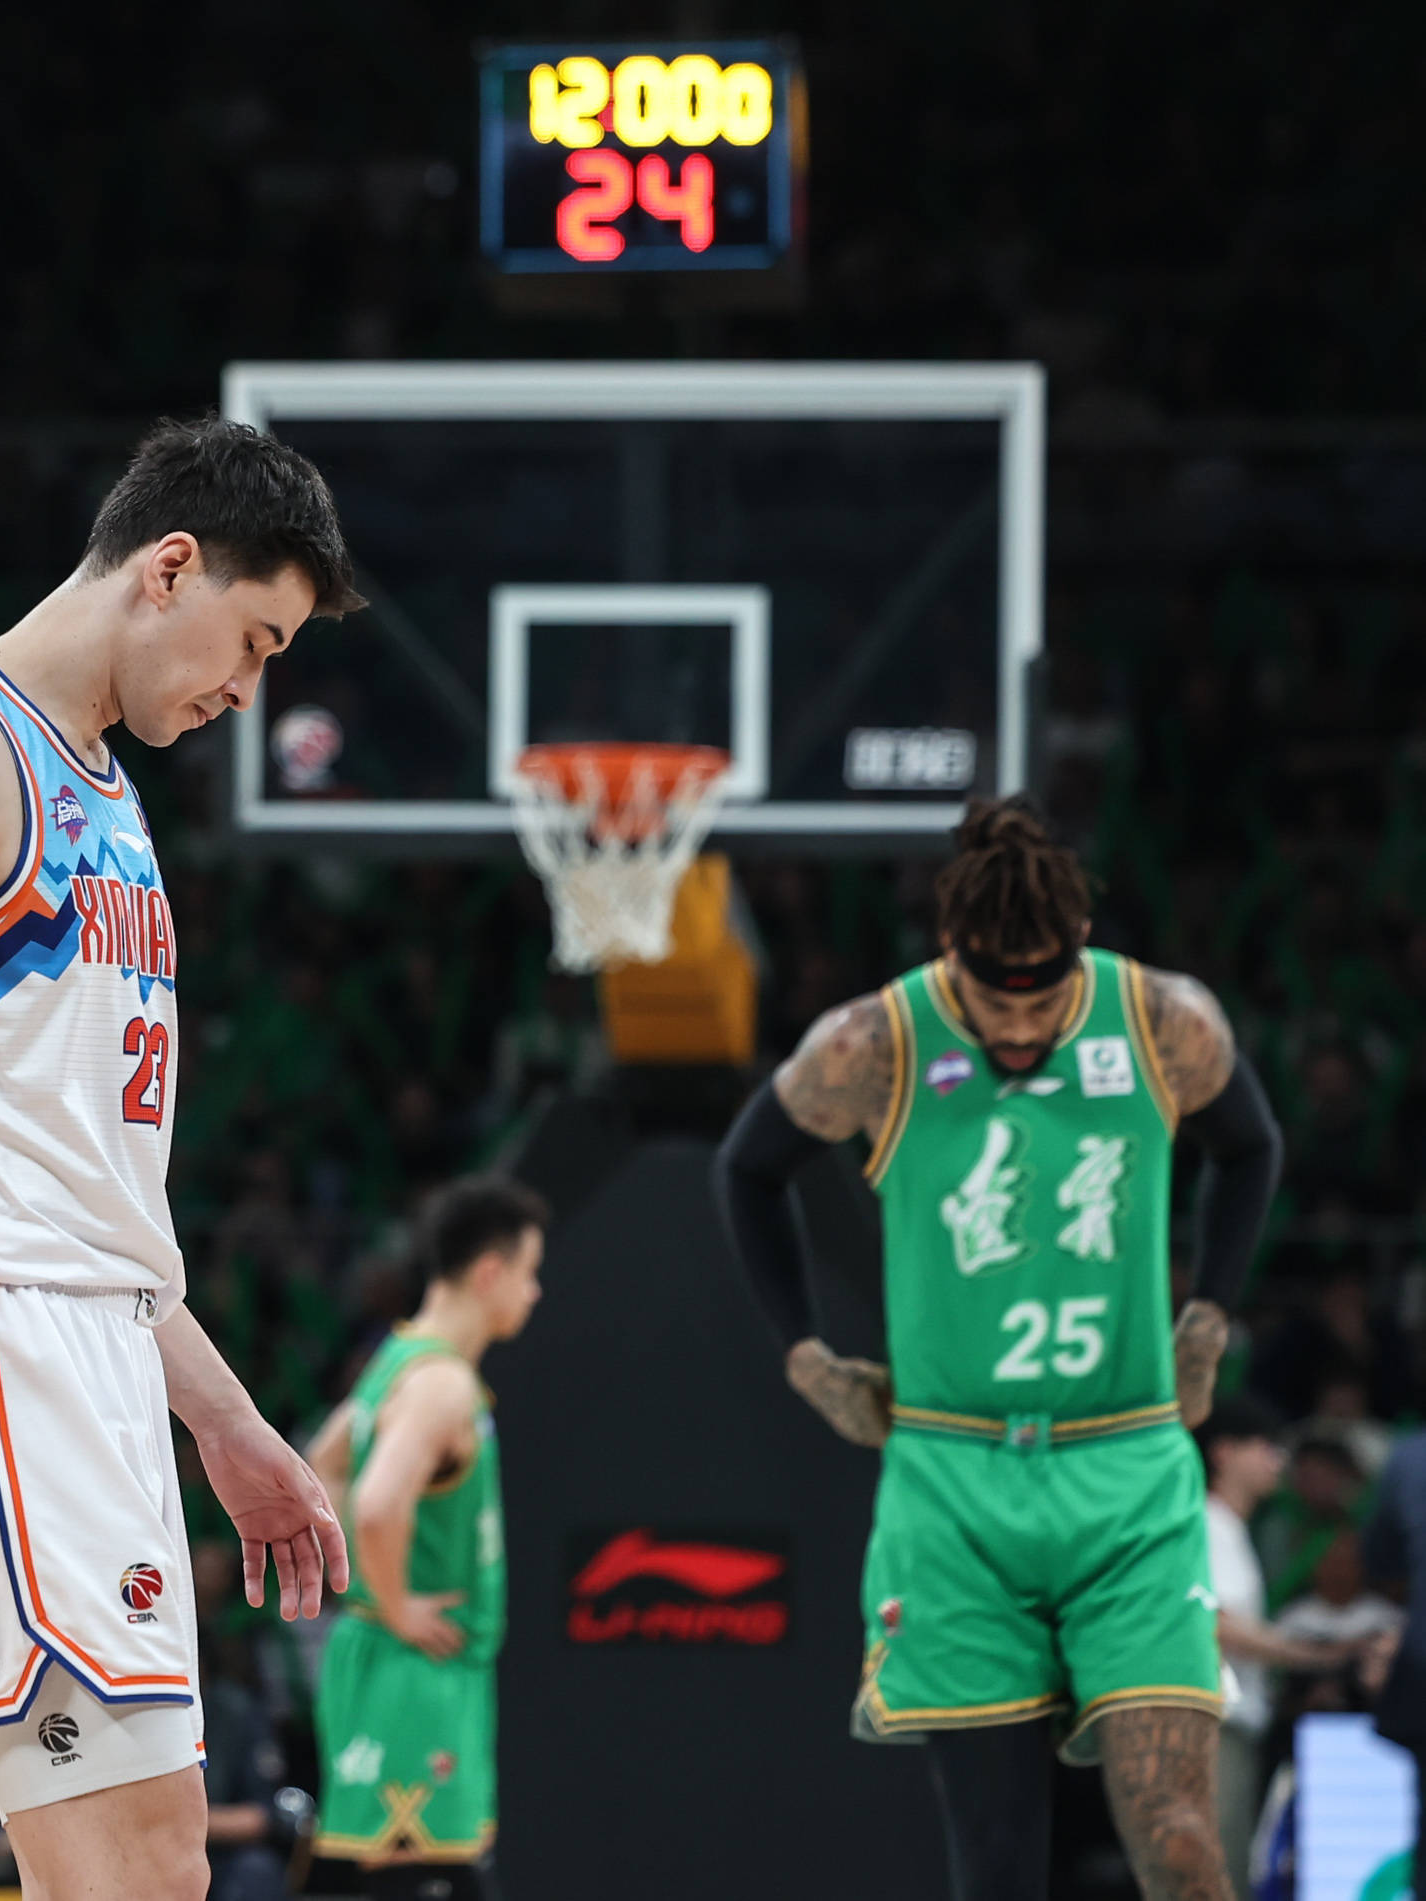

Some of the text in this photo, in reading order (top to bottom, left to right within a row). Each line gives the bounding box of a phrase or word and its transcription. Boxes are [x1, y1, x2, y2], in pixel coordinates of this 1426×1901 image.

[556, 148, 715, 262] 24
[122, 1016, 169, 1131] 23
[992, 1296, 1109, 1382] 25
[127, 1612, 158, 1624] CBA
[51, 1752, 82, 1767] CBA
